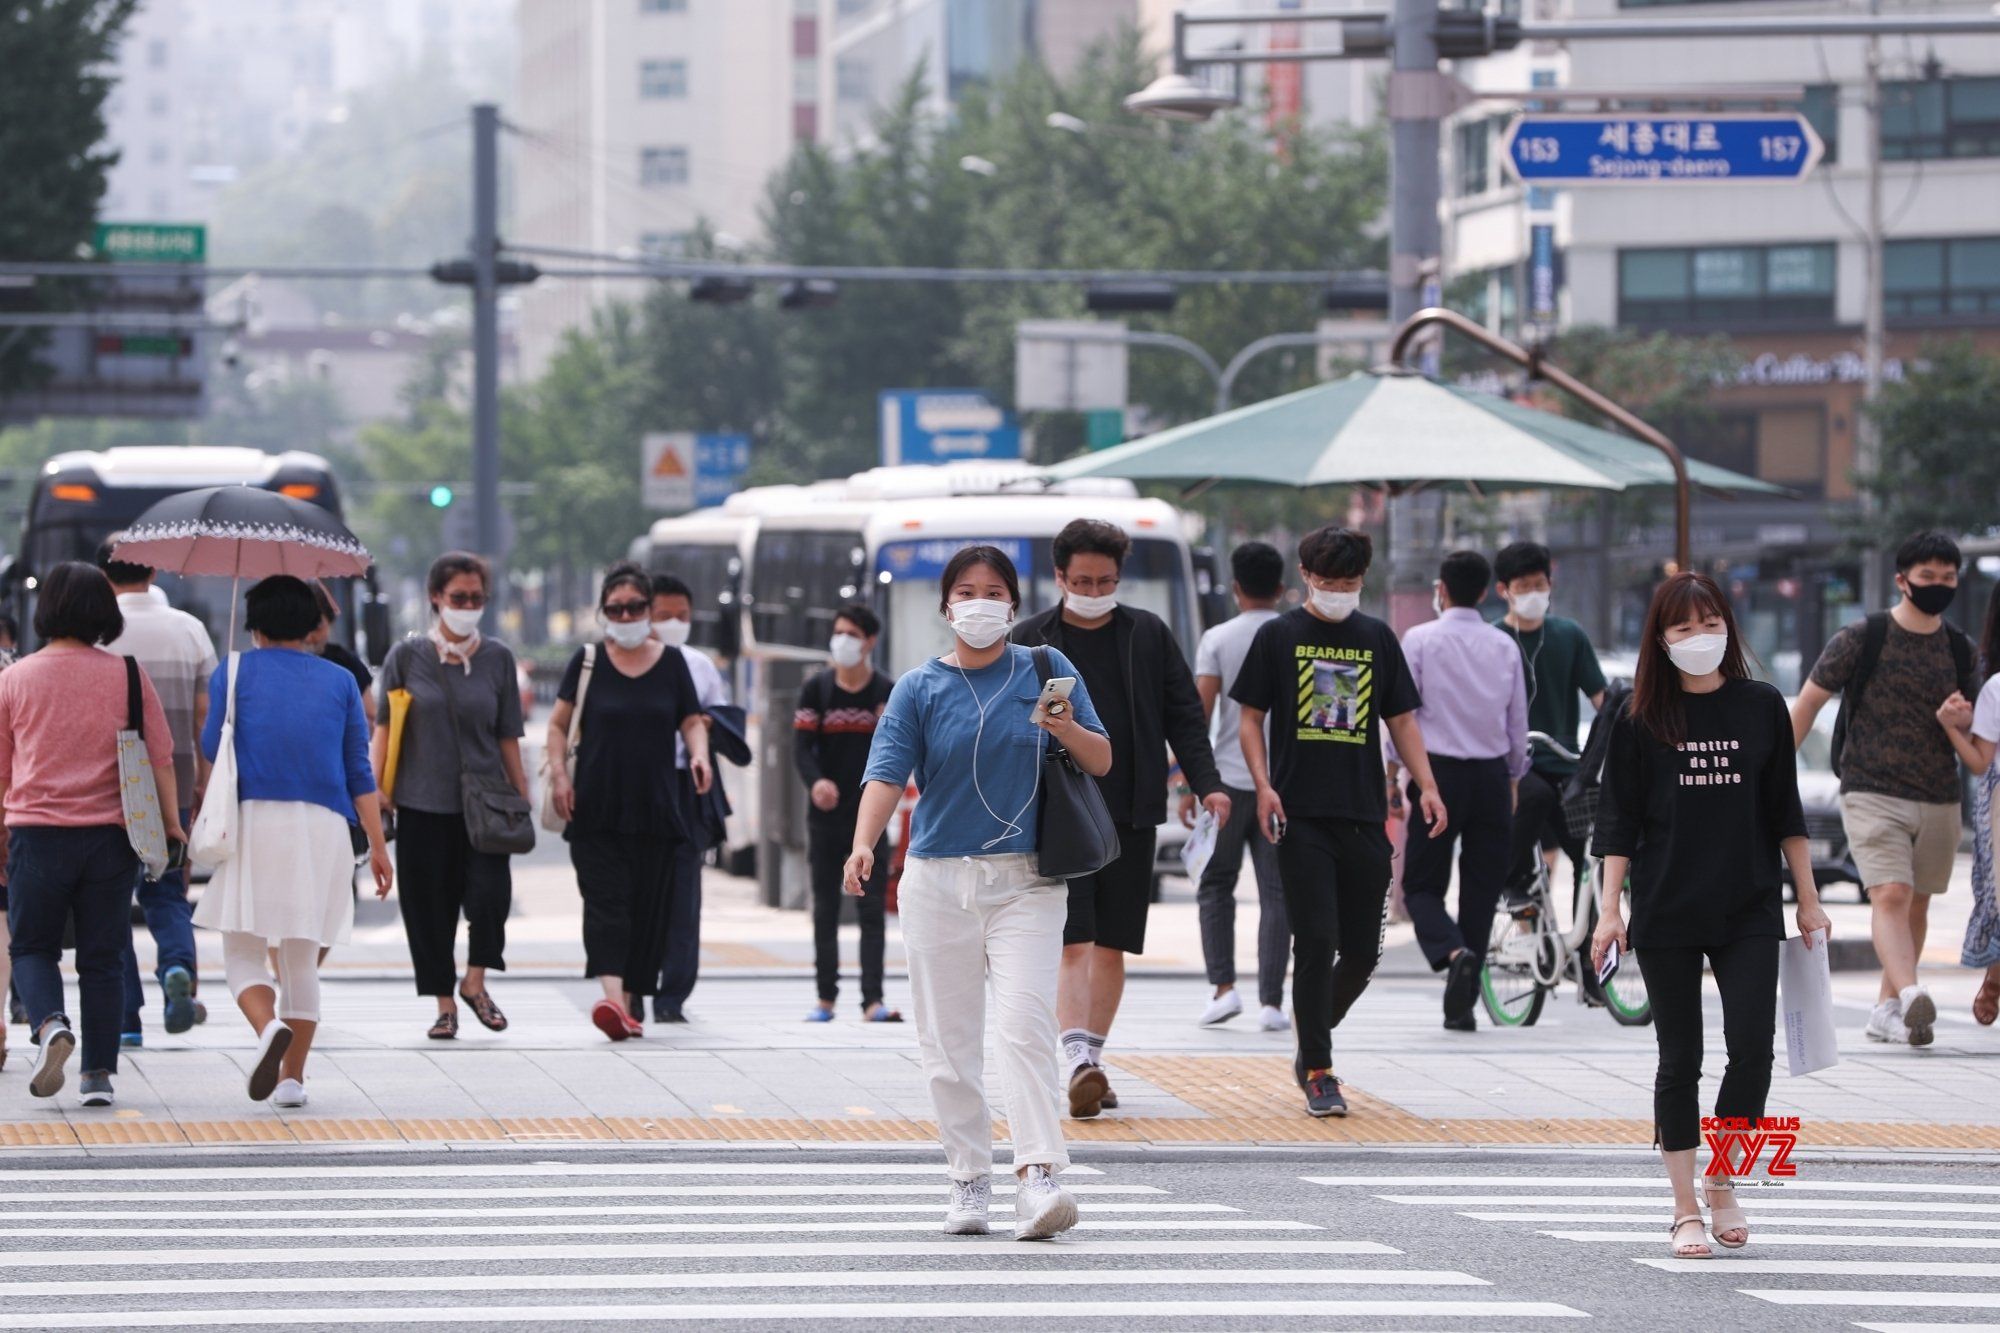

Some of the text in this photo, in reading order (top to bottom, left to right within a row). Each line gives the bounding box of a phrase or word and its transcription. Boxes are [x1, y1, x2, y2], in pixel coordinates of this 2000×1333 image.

[1600, 121, 1722, 154] 세종대로
[1760, 136, 1801, 162] 157
[1518, 137, 1560, 163] 153
[1588, 155, 1731, 178] Sejong-daero
[1295, 645, 1373, 662] BEARABLE
[1690, 755, 1729, 768] de la
[1679, 771, 1742, 786] lumière
